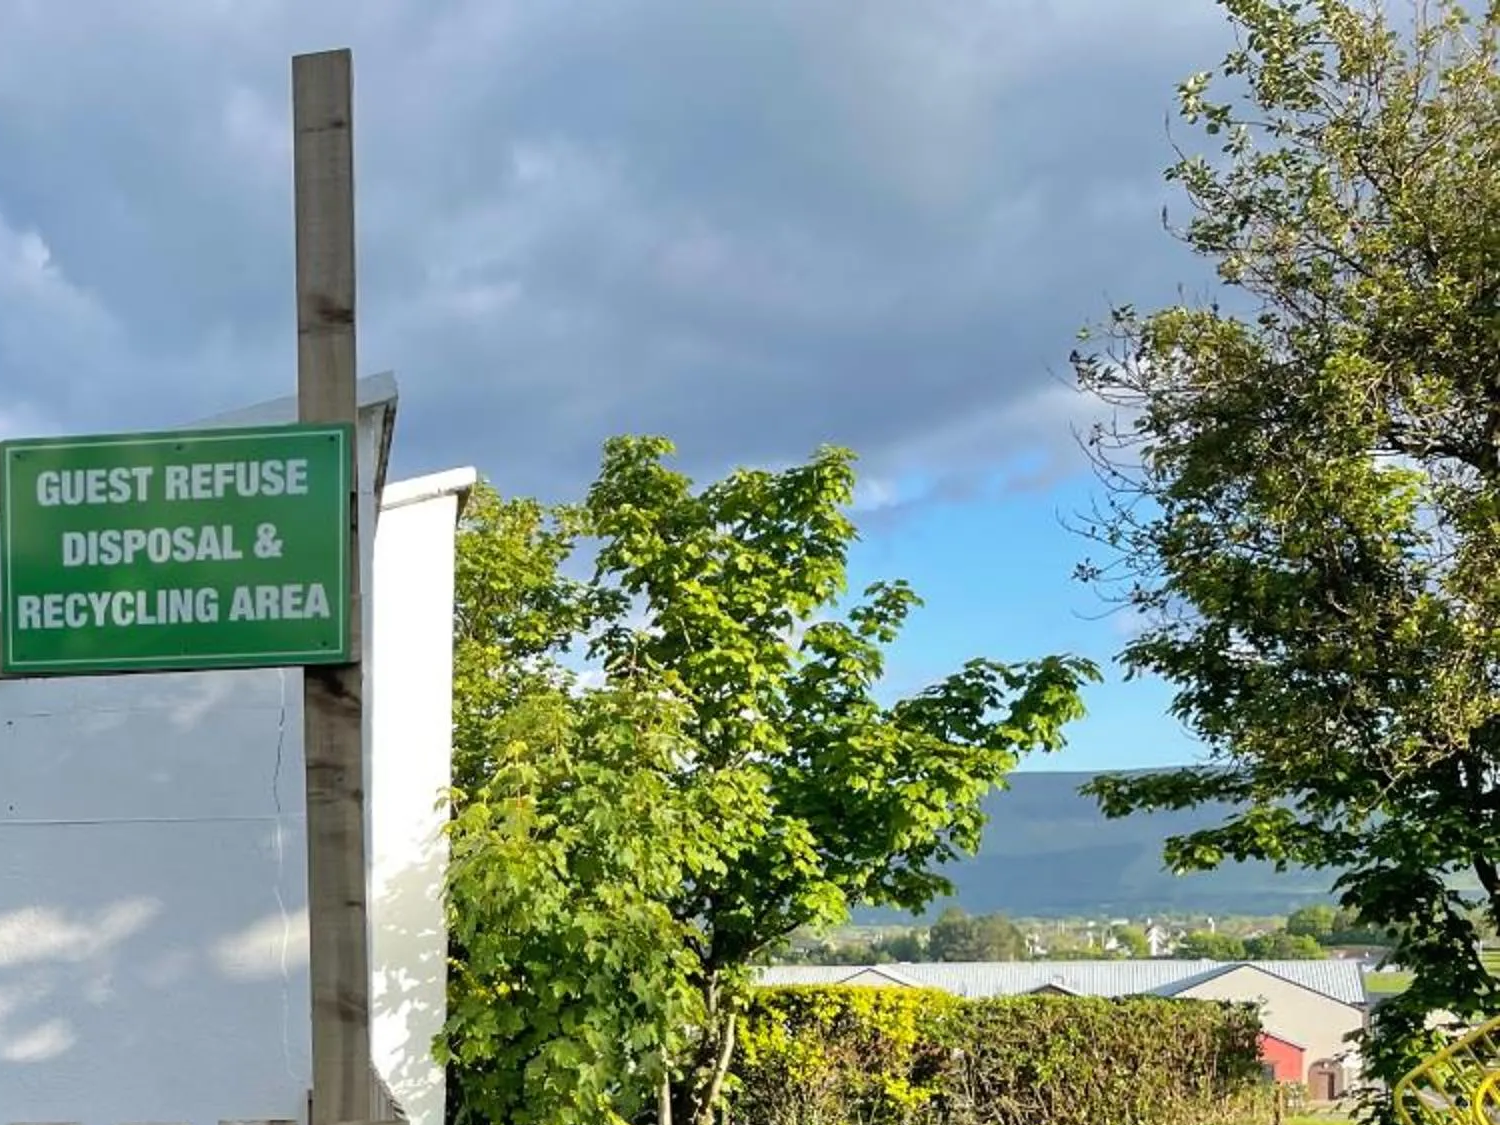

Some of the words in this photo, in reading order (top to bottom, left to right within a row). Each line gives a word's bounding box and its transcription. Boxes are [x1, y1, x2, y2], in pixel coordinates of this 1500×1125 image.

[36, 467, 153, 506] GUEST
[164, 459, 308, 500] REFUSE
[62, 525, 242, 567] DISPOSAL
[253, 523, 283, 558] &
[18, 587, 219, 629] RECYCLING
[228, 583, 330, 620] AREA
